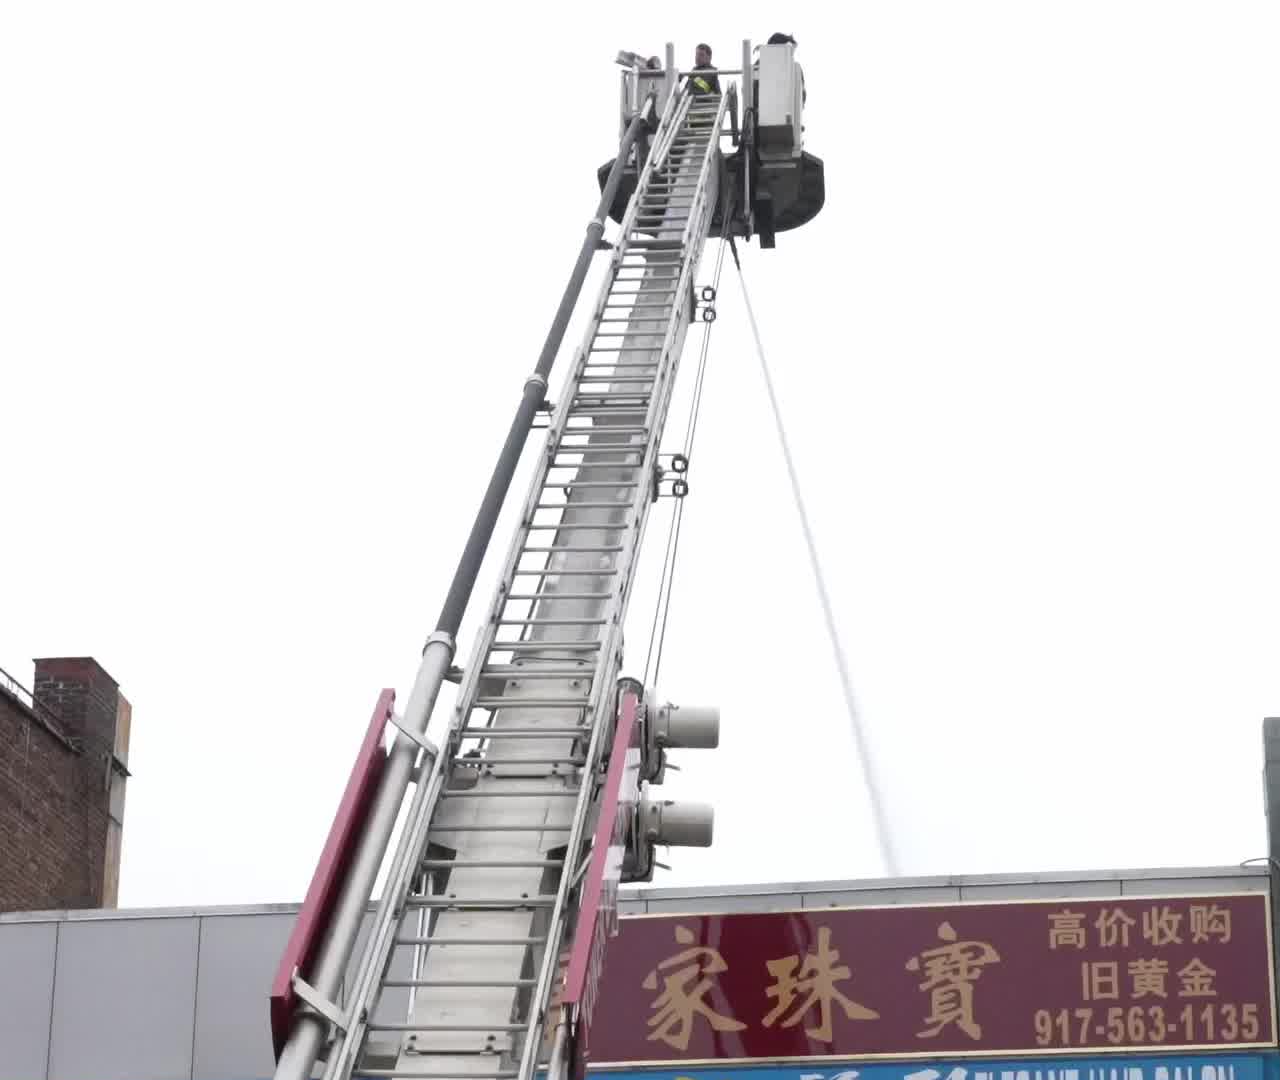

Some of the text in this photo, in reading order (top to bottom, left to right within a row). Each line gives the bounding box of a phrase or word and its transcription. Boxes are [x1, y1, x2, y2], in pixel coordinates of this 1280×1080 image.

[1047, 903, 1233, 950] 高价收购
[546, 920, 1002, 1051] 家珠寶
[1080, 957, 1218, 1001] 旧黄金
[1033, 1003, 1261, 1046] 917-563-1135
